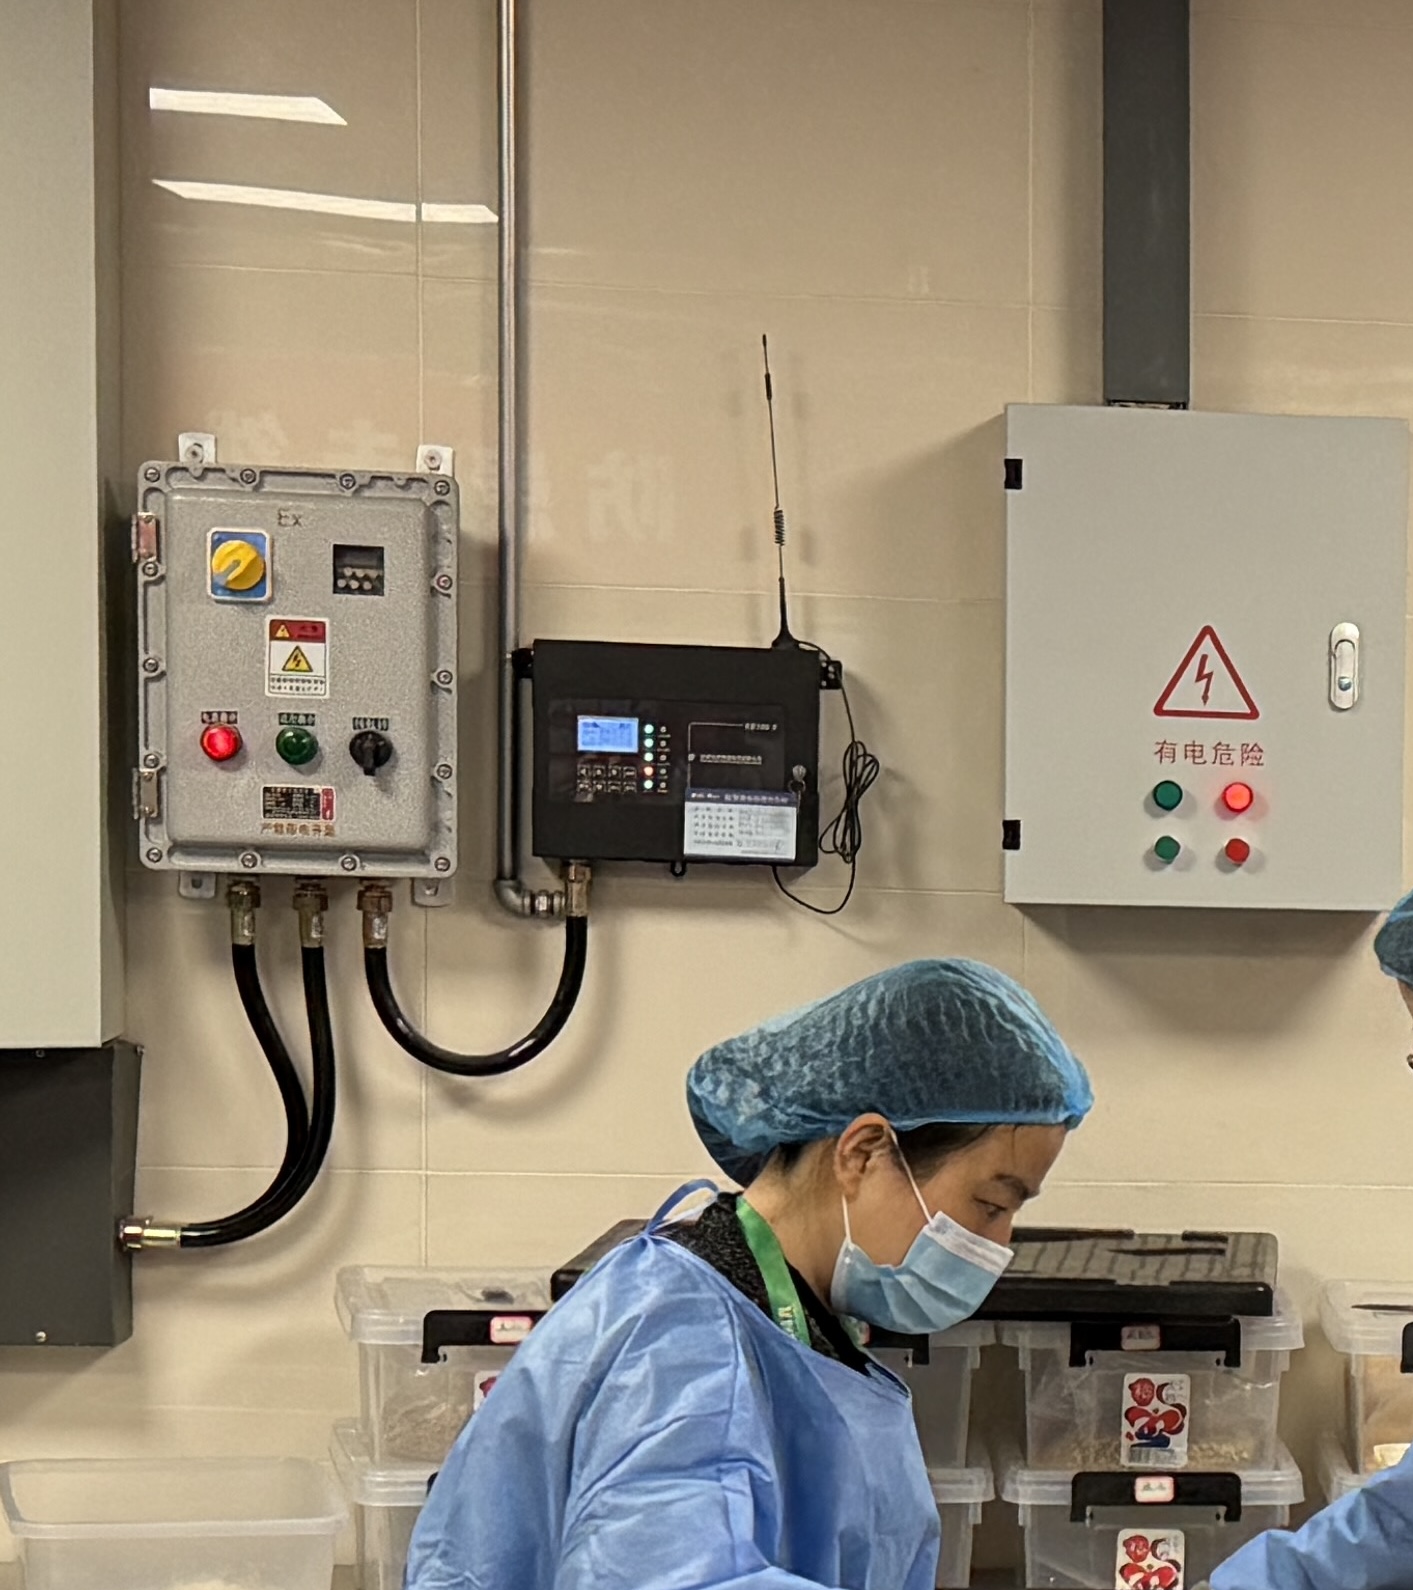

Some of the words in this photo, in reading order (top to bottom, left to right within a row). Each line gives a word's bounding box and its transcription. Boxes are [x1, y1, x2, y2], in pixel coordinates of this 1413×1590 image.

[277, 509, 303, 528] Ex
[1153, 739, 1265, 767] 有电危险
